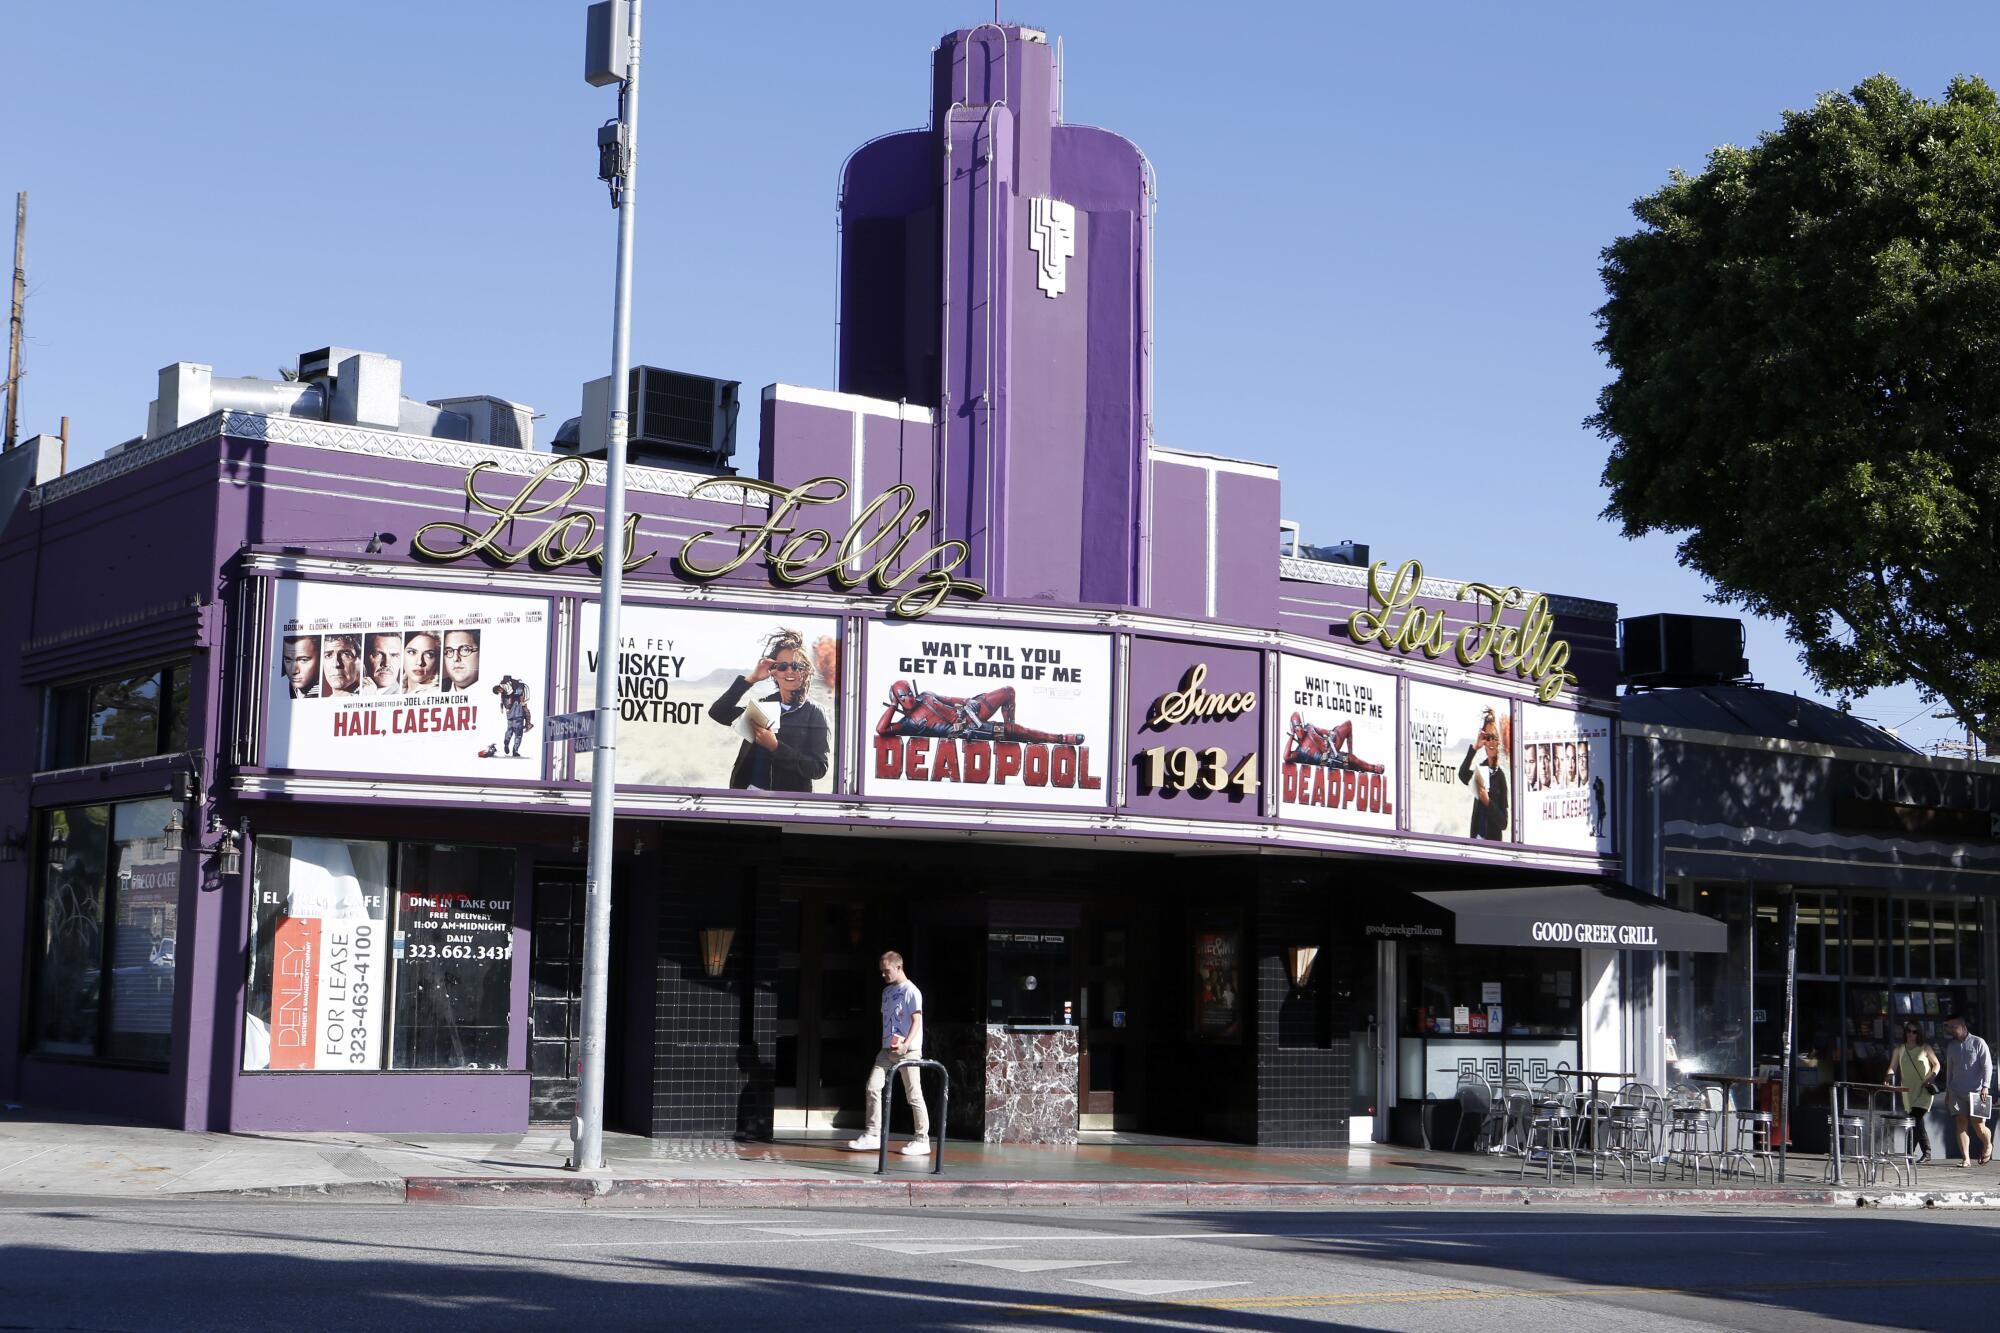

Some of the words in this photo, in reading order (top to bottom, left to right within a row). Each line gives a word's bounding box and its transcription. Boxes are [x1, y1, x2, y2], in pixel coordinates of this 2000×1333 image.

[413, 456, 657, 568] Los
[678, 476, 986, 617] Feliz
[284, 624, 304, 632] BROLIN
[1348, 560, 1453, 657] Los
[1456, 582, 1578, 702] Feliz
[647, 638, 674, 651] FEY
[922, 641, 972, 658] WAIT
[1021, 648, 1061, 664] YOU
[899, 657, 937, 674] GET
[943, 660, 956, 675] A
[963, 662, 1015, 679] LOAD
[1021, 665, 1046, 680] OF
[1052, 667, 1081, 683] ME
[404, 697, 420, 706] JOEL
[427, 696, 449, 705] ETHAN
[451, 695, 468, 704] COEN
[617, 676, 668, 700] ANGO
[1153, 663, 1257, 725] Since
[1305, 676, 1330, 693] WAIT
[1353, 685, 1372, 701] YOU
[1294, 690, 1313, 707] GET
[1317, 694, 1323, 708] A
[1327, 696, 1351, 713] LOAD
[1355, 701, 1366, 715] OF
[1369, 704, 1382, 719] ME
[334, 710, 386, 737] HAIL,
[392, 706, 478, 734] CAESAR!
[551, 718, 578, 736] Russell
[581, 716, 591, 732] Av
[1409, 721, 1448, 746] WHISKEY
[873, 735, 1101, 789] DEADPOOL
[1415, 741, 1441, 763] TANGO
[1146, 745, 1261, 796] 1934
[1419, 761, 1456, 784] FOXTROT
[1282, 762, 1392, 815] DEADPOOL
[157, 872, 177, 888] CAFE
[263, 891, 280, 904] EL
[410, 897, 436, 907] DINE
[440, 898, 452, 908] IN
[460, 899, 486, 909] TAKE
[489, 900, 511, 910] OUT
[414, 921, 438, 929] 11:00
[441, 921, 506, 931] AM-MIDNIGHT
[429, 911, 449, 919] FREE
[455, 912, 491, 920] DELIVERY
[447, 934, 473, 943] DAILY
[1532, 921, 1573, 942] GOOD
[1574, 923, 1617, 944] GREEK
[1618, 925, 1658, 945] GRILL
[304, 941, 312, 968] COMPANY
[329, 933, 348, 1001] LEASE
[278, 941, 305, 1047] DENLEY
[350, 925, 372, 1064] 323-463-4100
[326, 1009, 345, 1055] FOR
